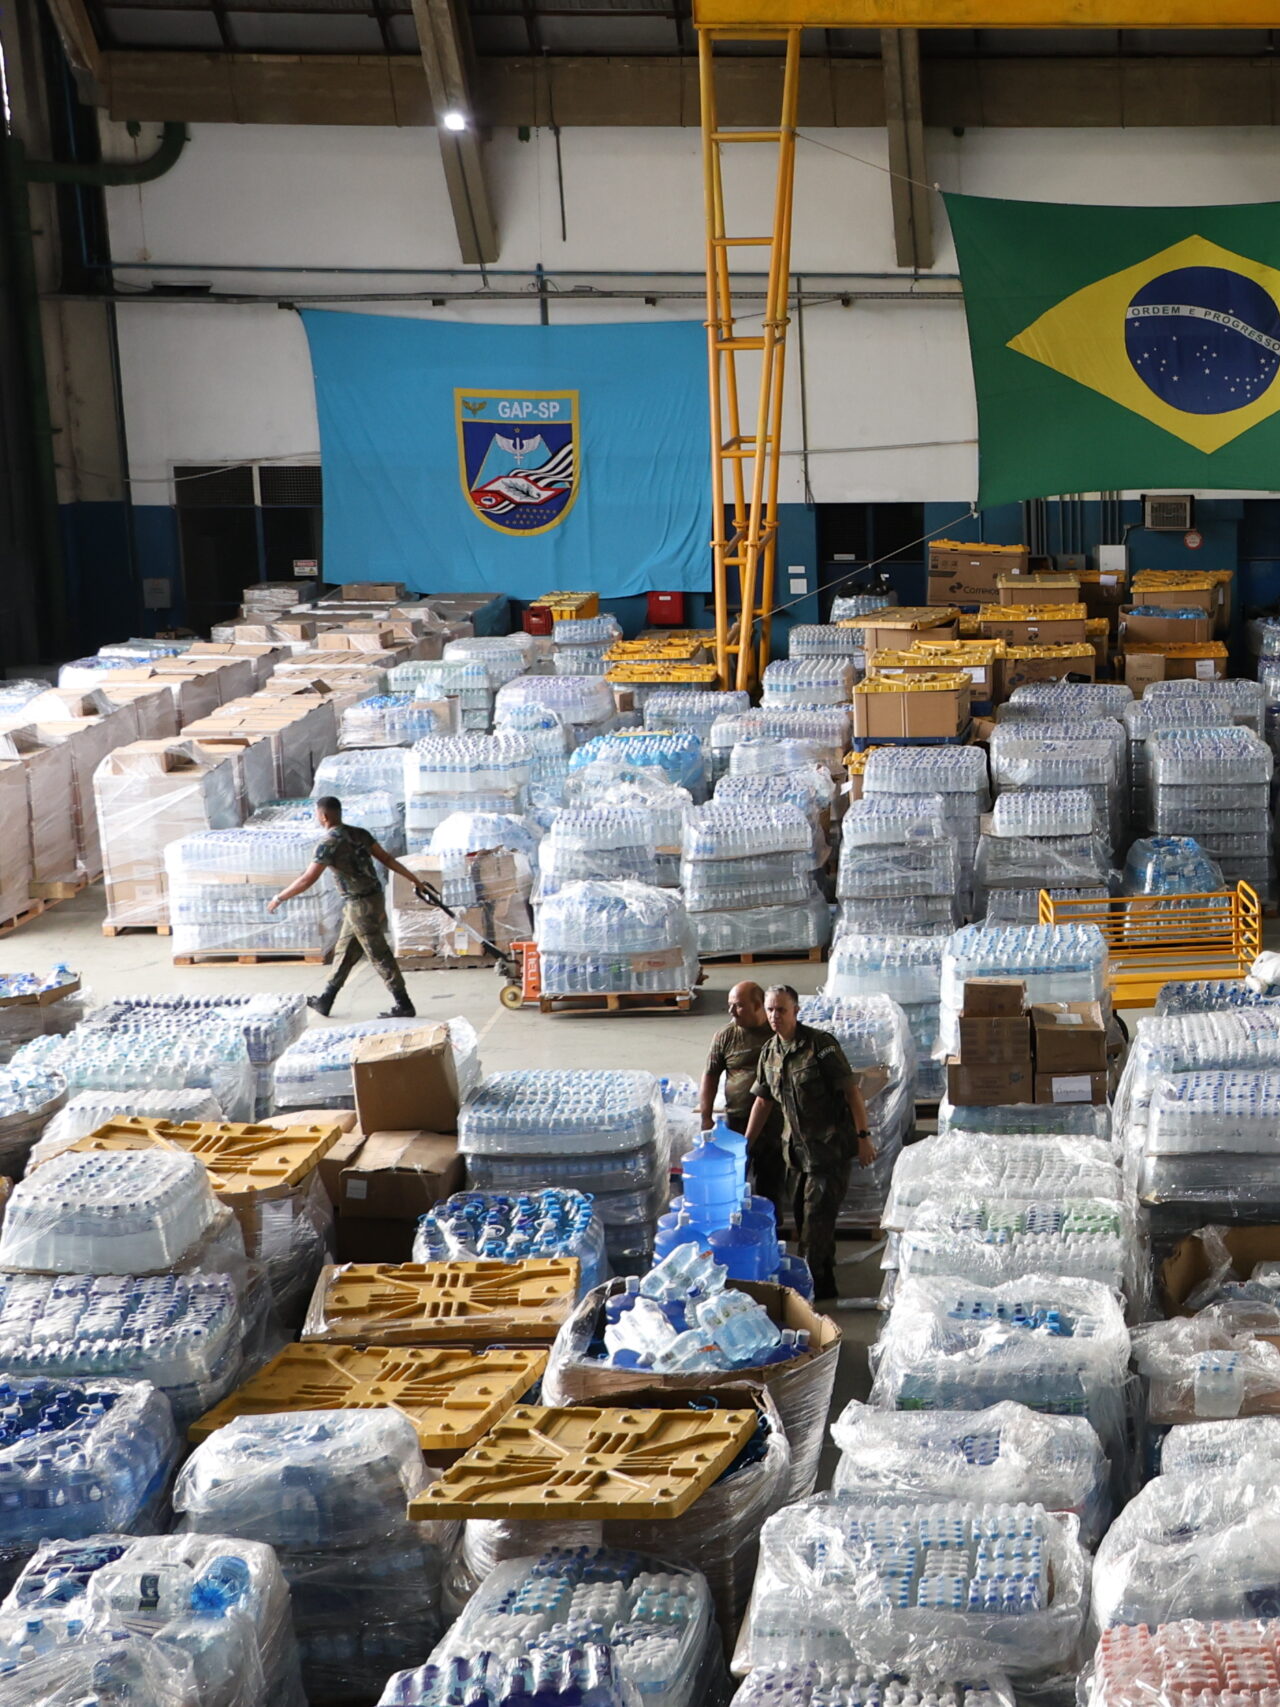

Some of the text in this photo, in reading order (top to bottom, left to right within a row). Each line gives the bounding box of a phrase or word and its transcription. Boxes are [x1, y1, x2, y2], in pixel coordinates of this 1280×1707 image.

[1131, 305, 1181, 316] ORDEM
[1203, 311, 1280, 351] PROGRESSO
[498, 401, 560, 419] GAP-SP
